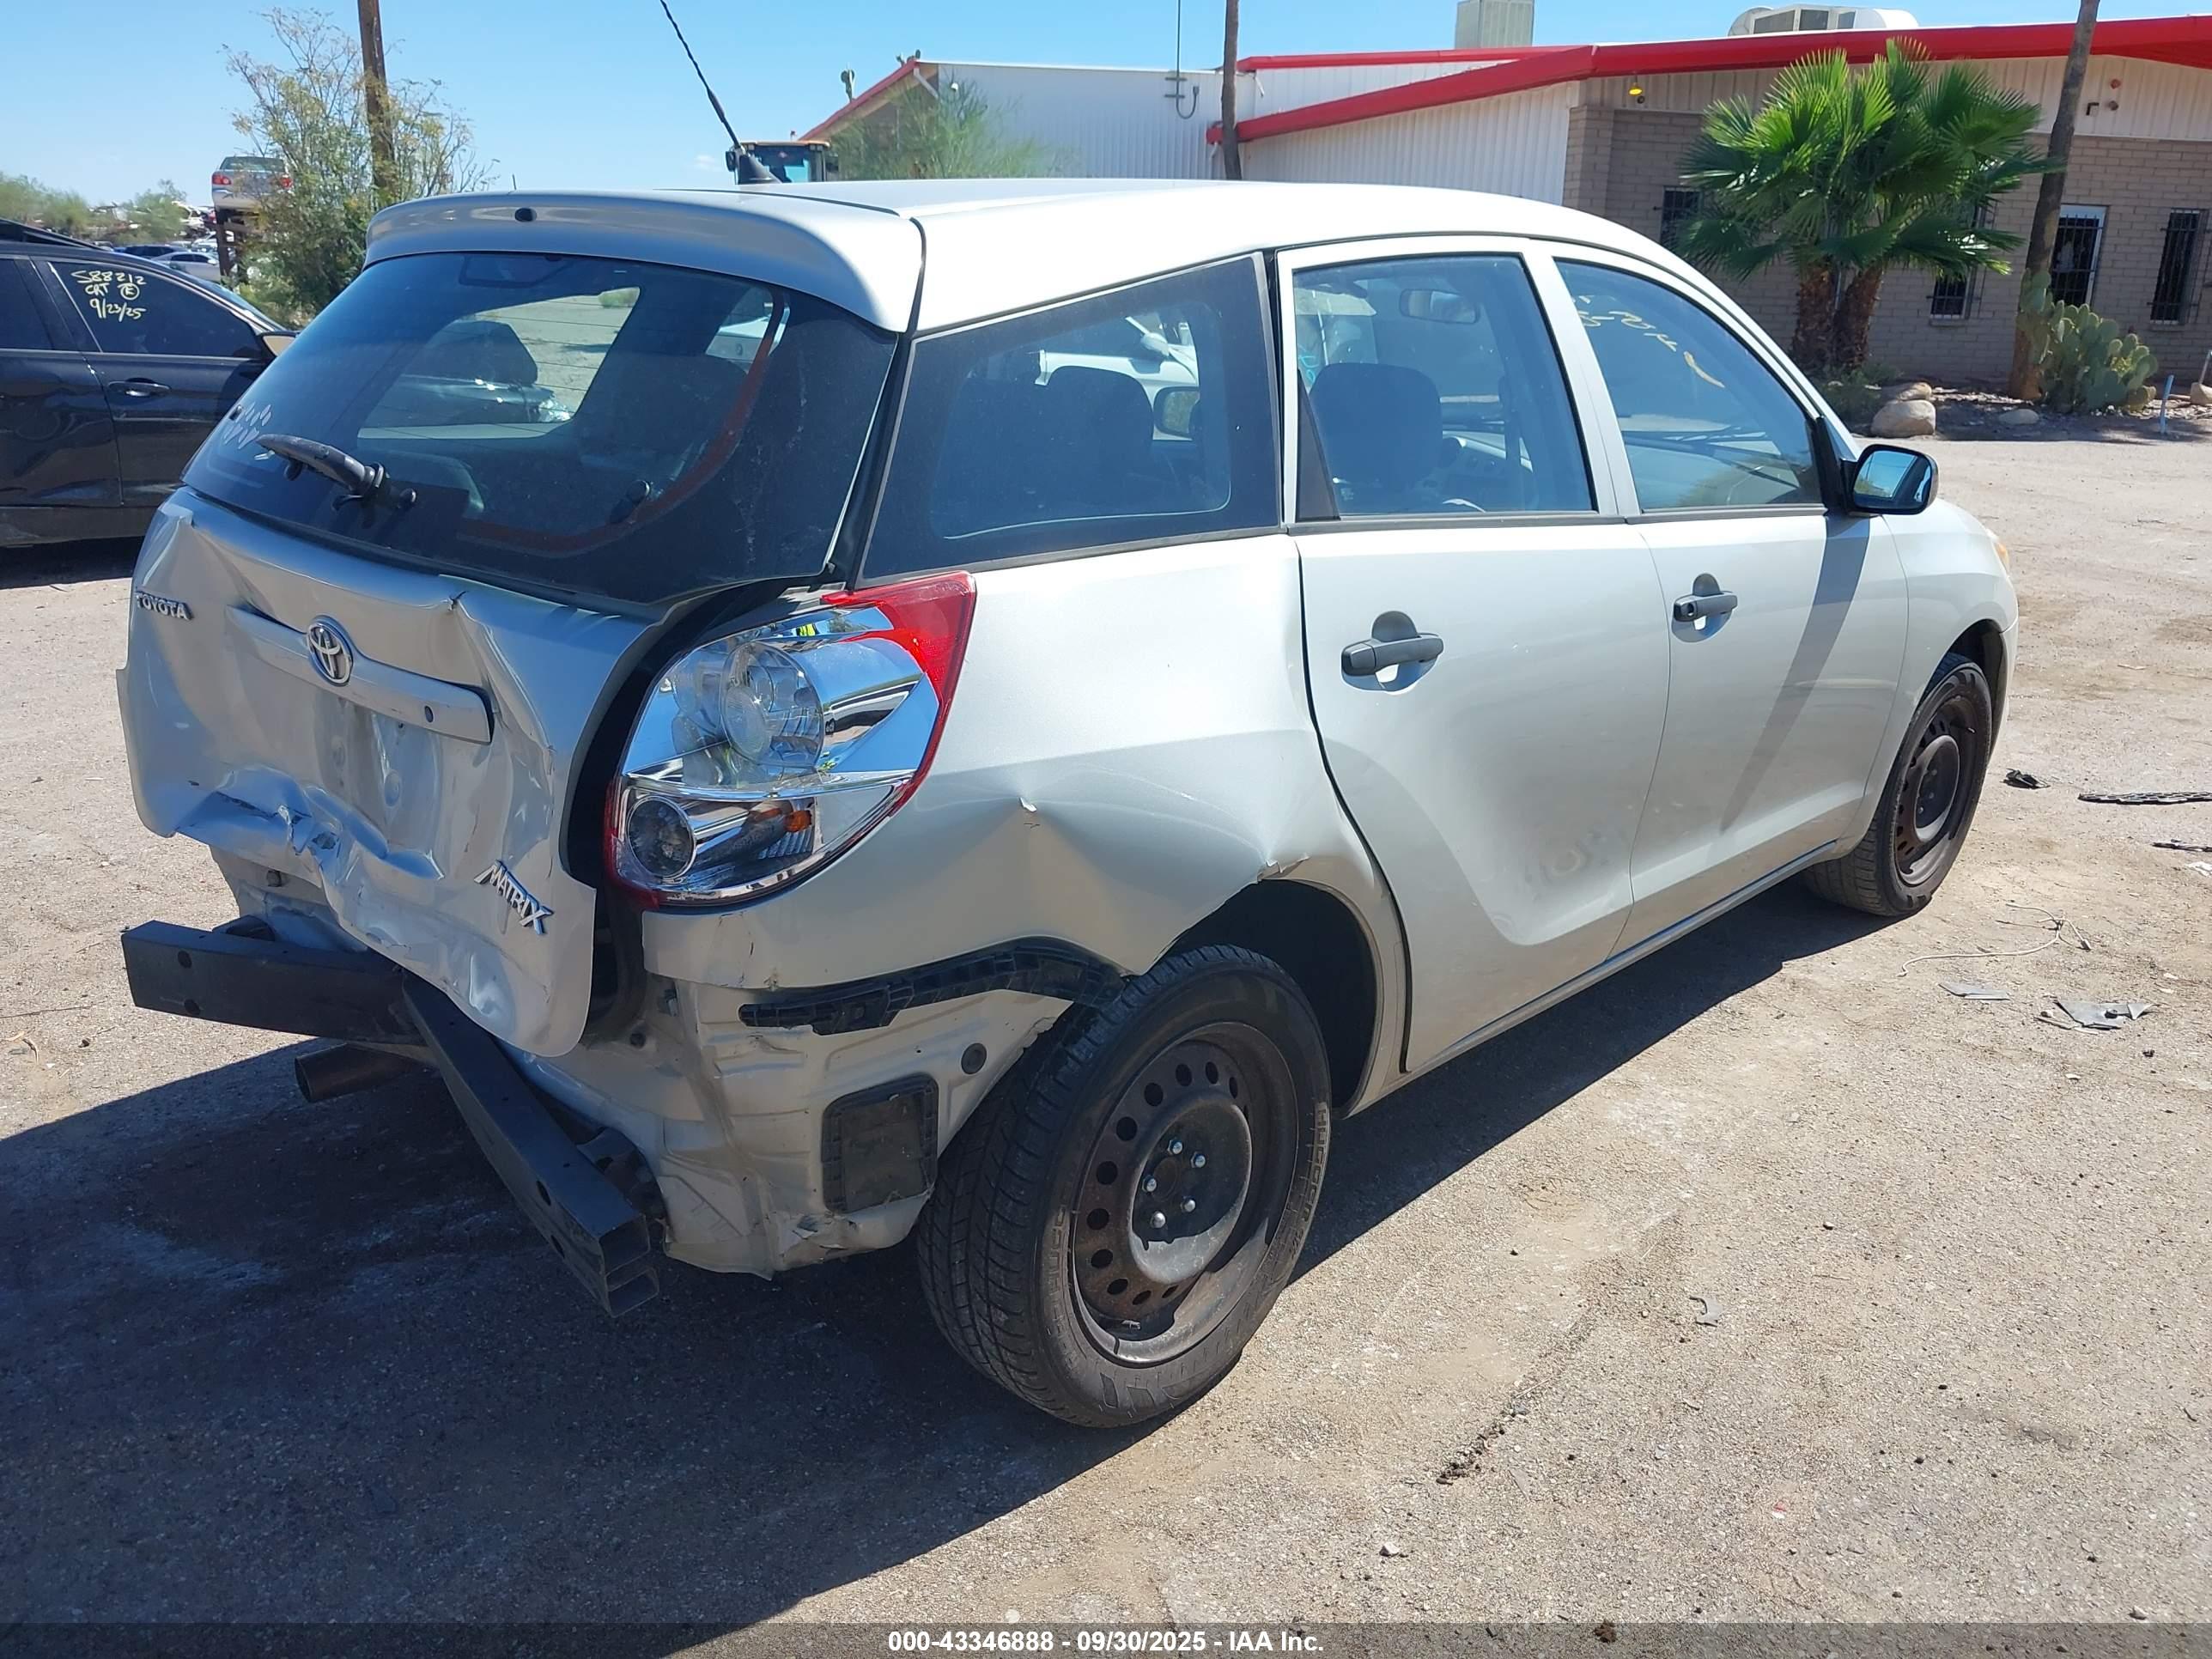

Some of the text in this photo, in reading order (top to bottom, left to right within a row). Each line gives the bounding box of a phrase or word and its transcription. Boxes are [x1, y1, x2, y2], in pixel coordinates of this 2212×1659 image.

[89, 298, 146, 323] 9/23/25
[136, 592, 194, 620] TOYOTA
[474, 859, 554, 934] MATRIX
